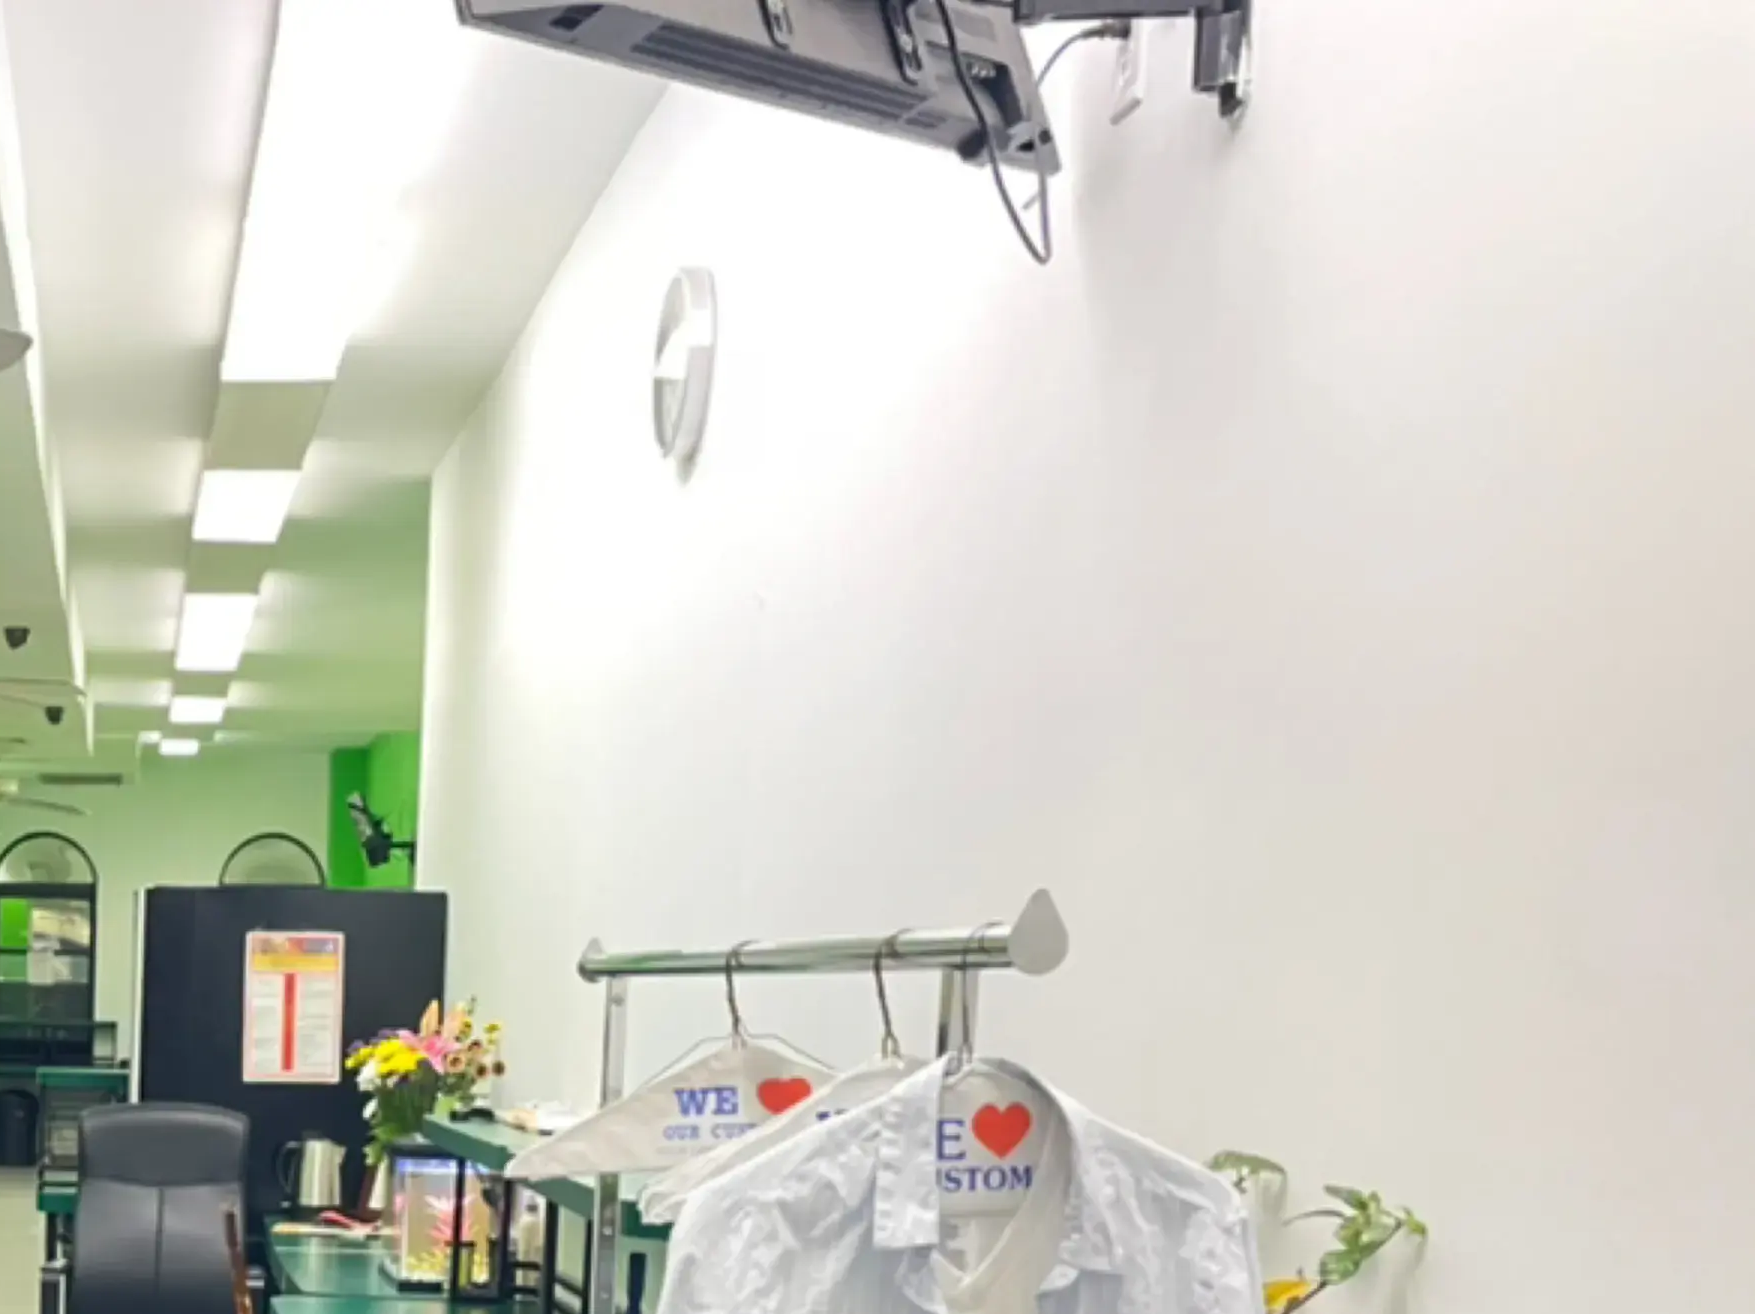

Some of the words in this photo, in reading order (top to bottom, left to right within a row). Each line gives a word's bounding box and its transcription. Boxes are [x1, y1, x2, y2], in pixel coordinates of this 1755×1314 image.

[673, 1087, 739, 1117] WE
[662, 1125, 700, 1141] OUR
[711, 1123, 757, 1139] CUS
[936, 1118, 966, 1161] E
[935, 1165, 1032, 1192] STOM
